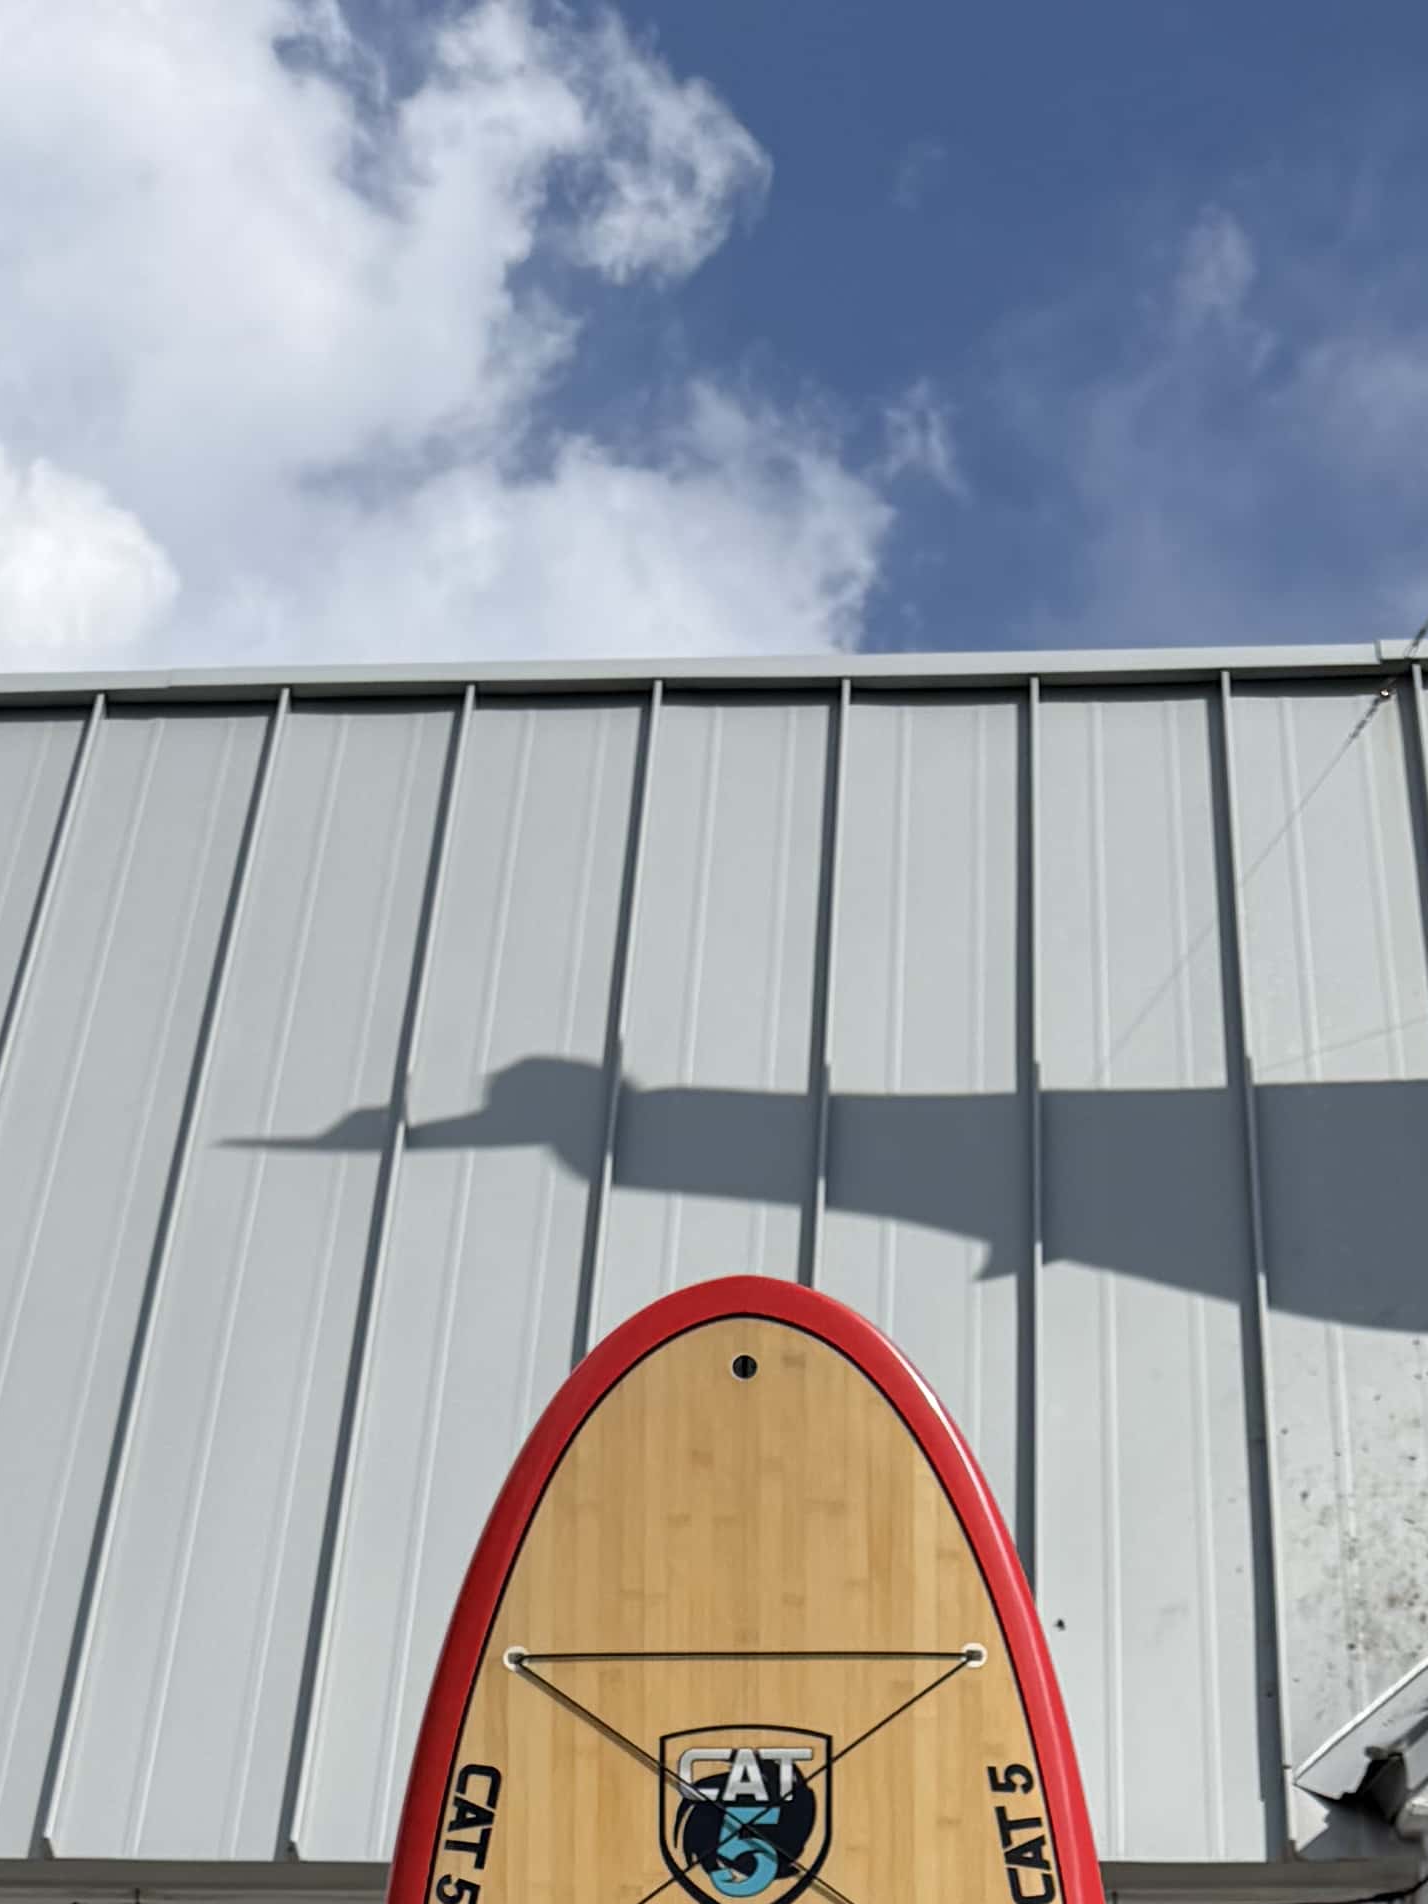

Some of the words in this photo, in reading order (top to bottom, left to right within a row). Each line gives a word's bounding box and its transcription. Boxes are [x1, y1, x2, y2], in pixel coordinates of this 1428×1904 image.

[678, 1747, 814, 1804] CAT
[988, 1763, 1033, 1795] 5
[444, 1764, 502, 1870] CAT
[709, 1805, 783, 1898] 5
